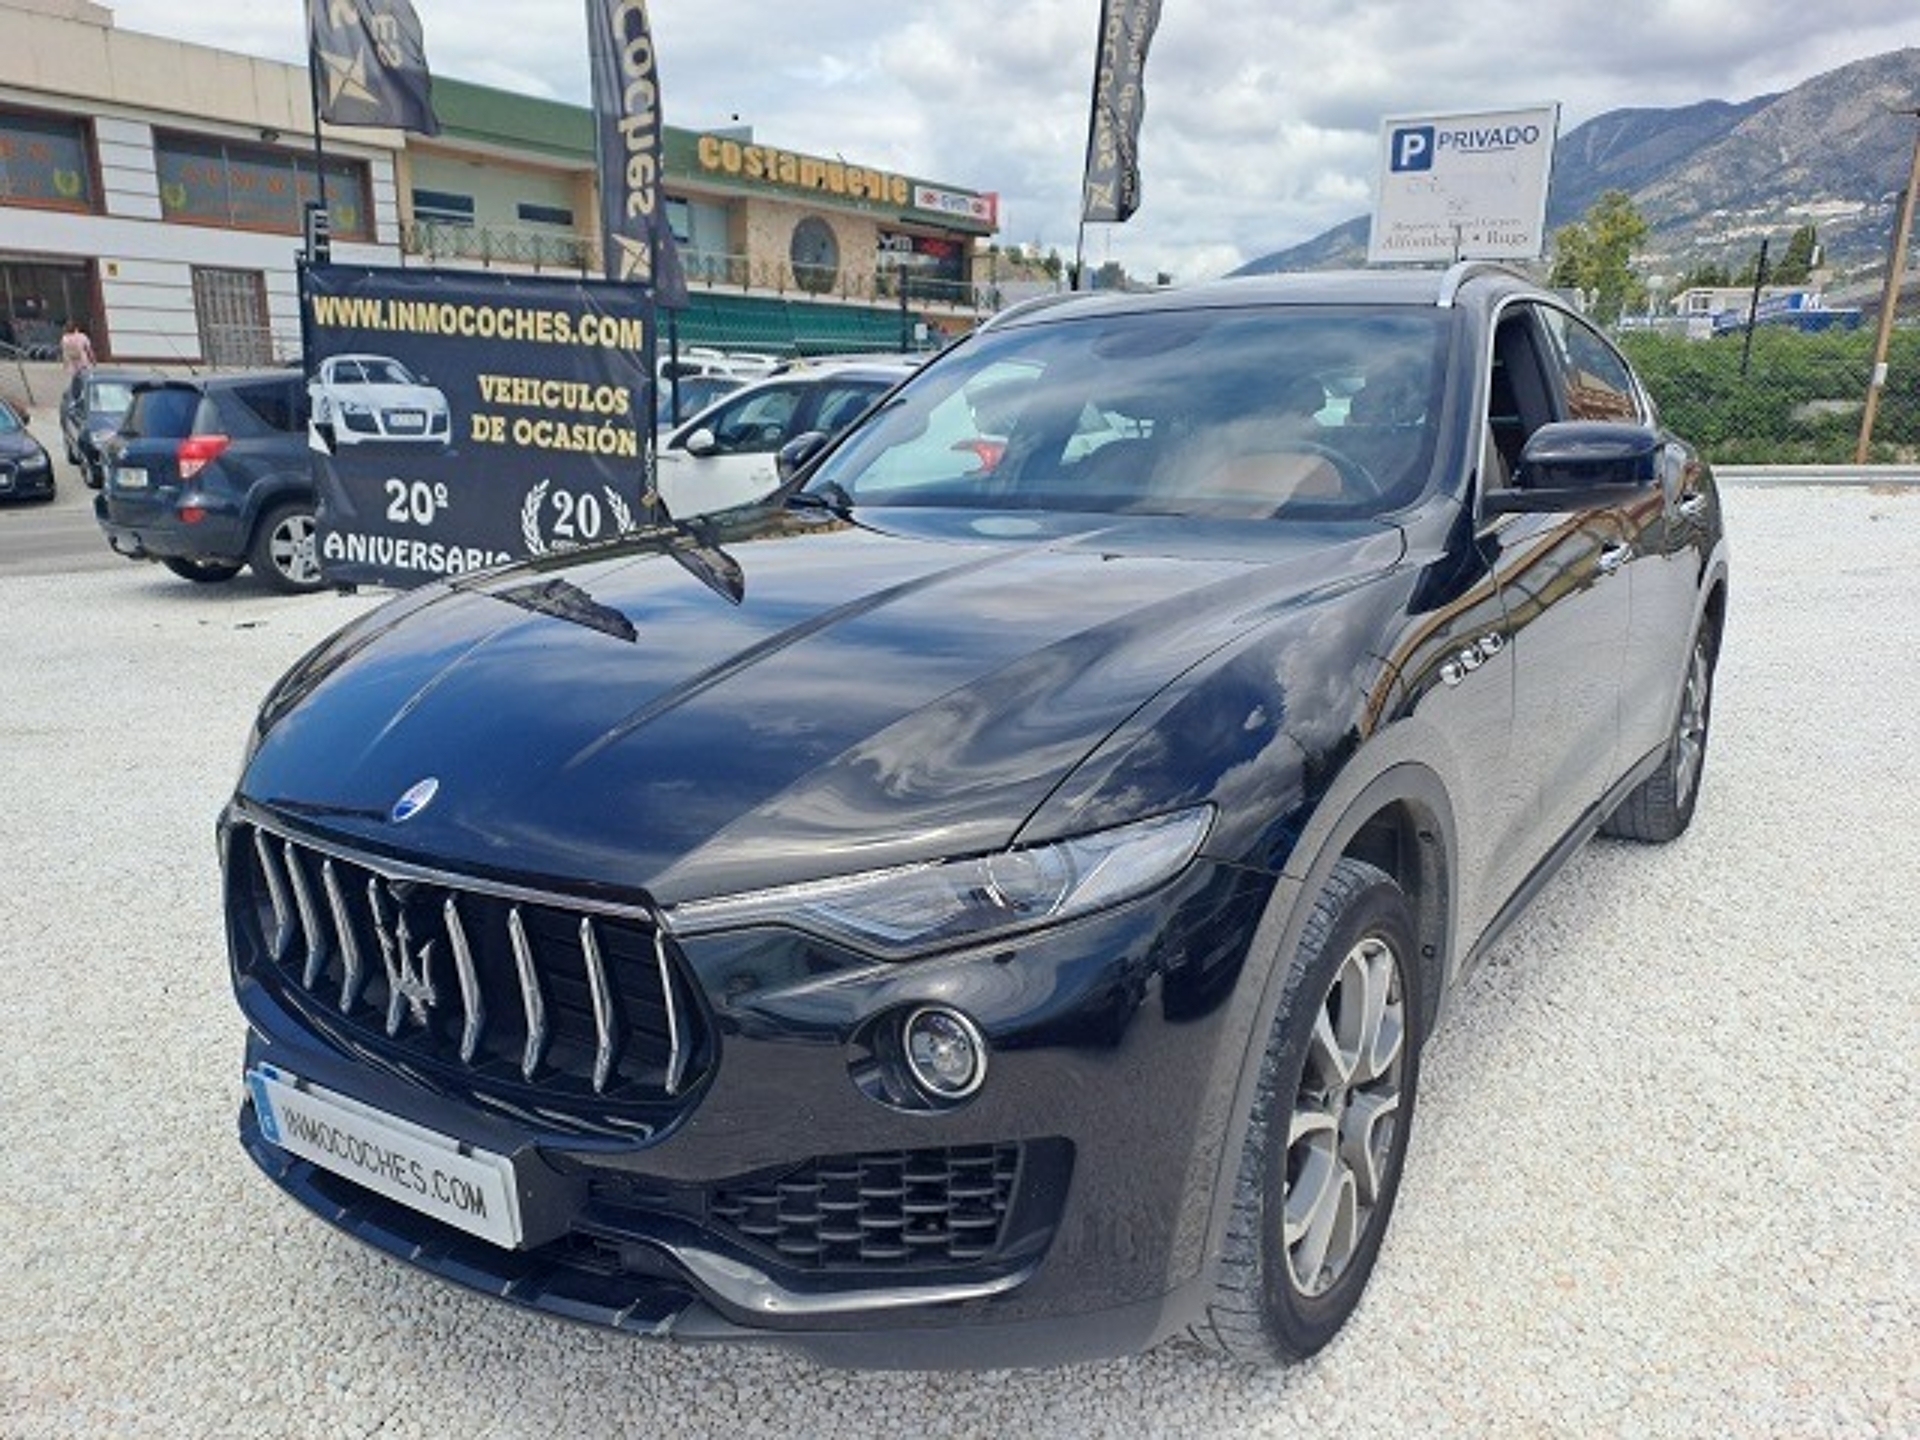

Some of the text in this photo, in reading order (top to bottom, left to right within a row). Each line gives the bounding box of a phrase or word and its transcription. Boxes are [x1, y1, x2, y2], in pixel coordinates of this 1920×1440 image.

[1400, 125, 1540, 166] P PRIVADO
[312, 295, 643, 350] WWW.INMOCOCHES.COM
[478, 374, 631, 415] VEHICULOS
[471, 413, 638, 457] DE OCASIÓN
[551, 490, 601, 539] 20
[282, 1105, 488, 1219] INMOCOCHES.COM
